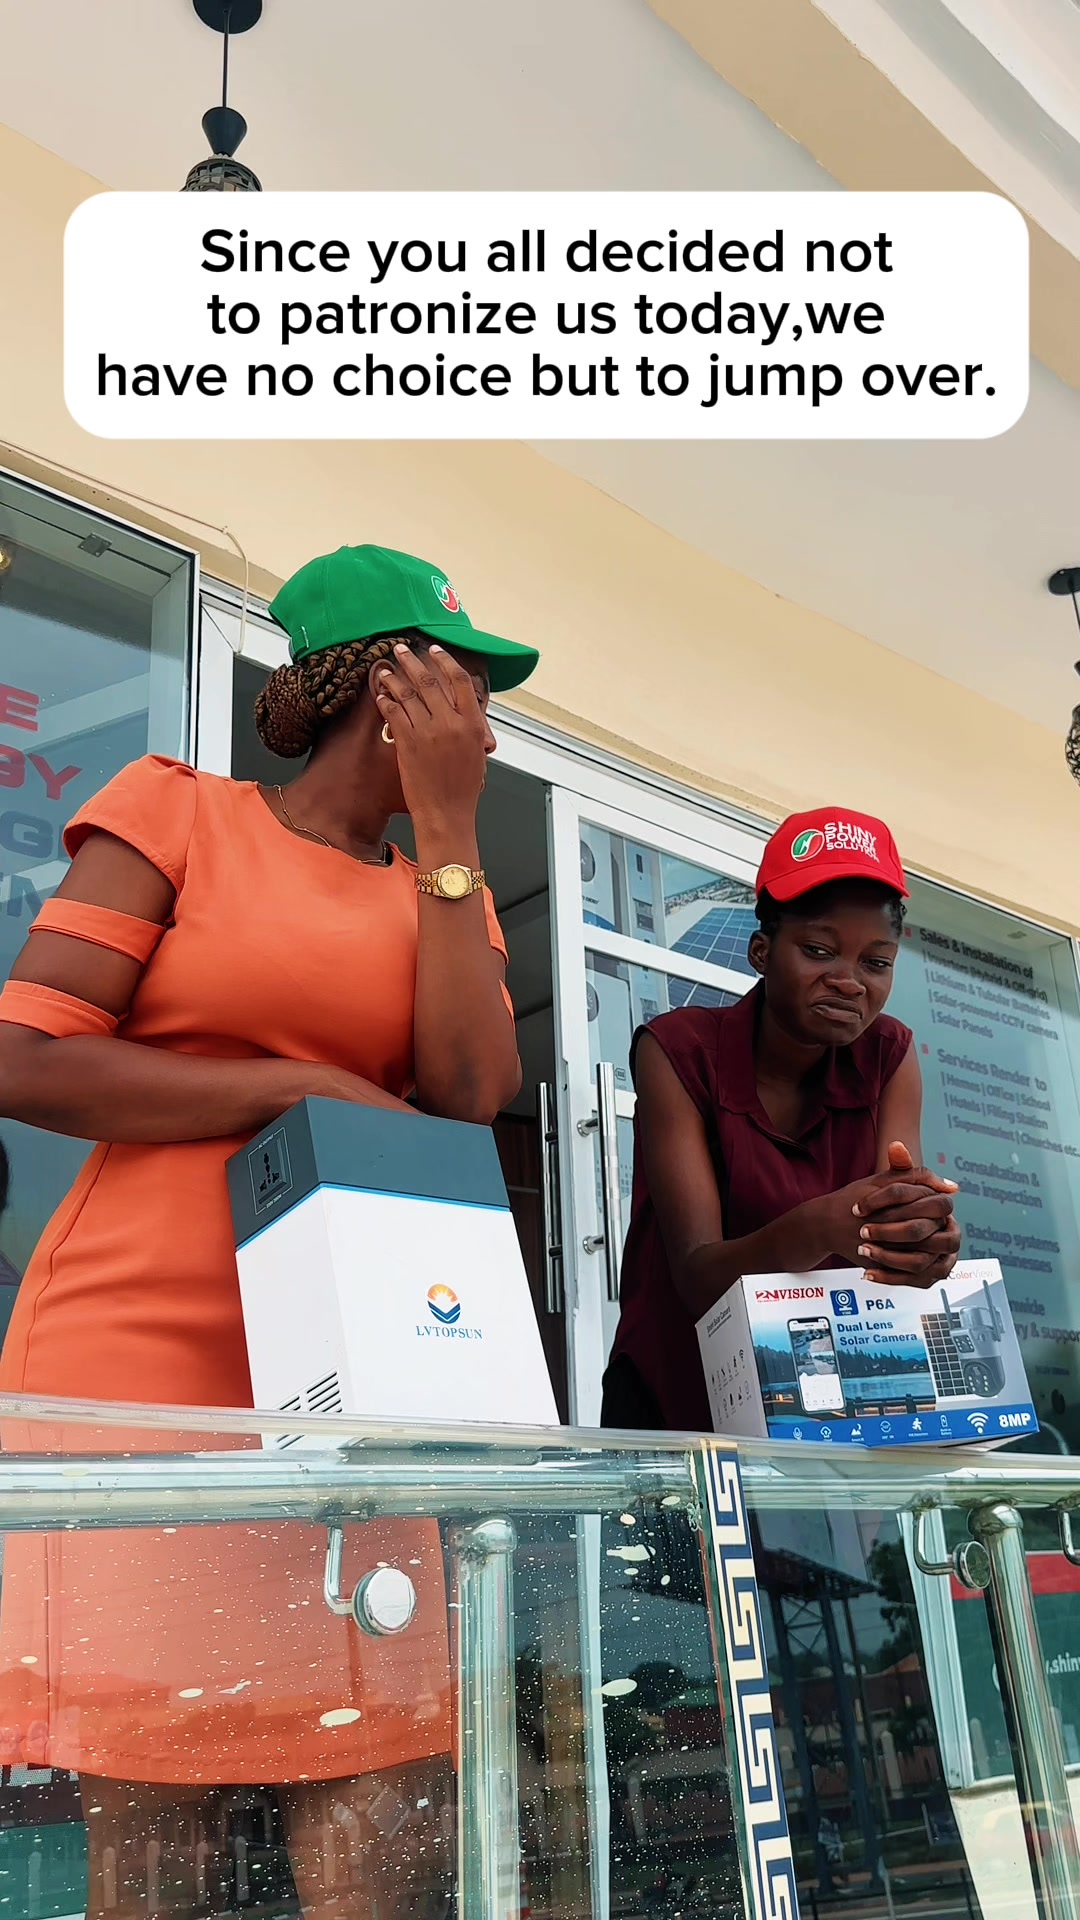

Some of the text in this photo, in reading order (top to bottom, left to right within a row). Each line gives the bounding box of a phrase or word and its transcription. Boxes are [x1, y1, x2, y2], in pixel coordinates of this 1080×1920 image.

[824, 821, 877, 844] SHINY
[920, 928, 1033, 979] Sales & installation of
[936, 1011, 961, 1029] Solar
[1001, 1013, 1024, 1029] CCTV
[937, 1048, 1047, 1092] Services Render to
[986, 1084, 1014, 1102] Office
[1021, 1093, 1051, 1112] School
[954, 1155, 1040, 1187] Consultation &
[981, 1181, 1043, 1209] inspection
[965, 1223, 1060, 1253] Backup systems
[866, 1298, 895, 1311] P6A
[416, 1325, 482, 1340] LVTOPSUN
[837, 1320, 893, 1333] Dual Lens
[1031, 1321, 1039, 1338] &
[840, 1333, 917, 1346] Solar Camera
[999, 1412, 1031, 1428] 8MP
